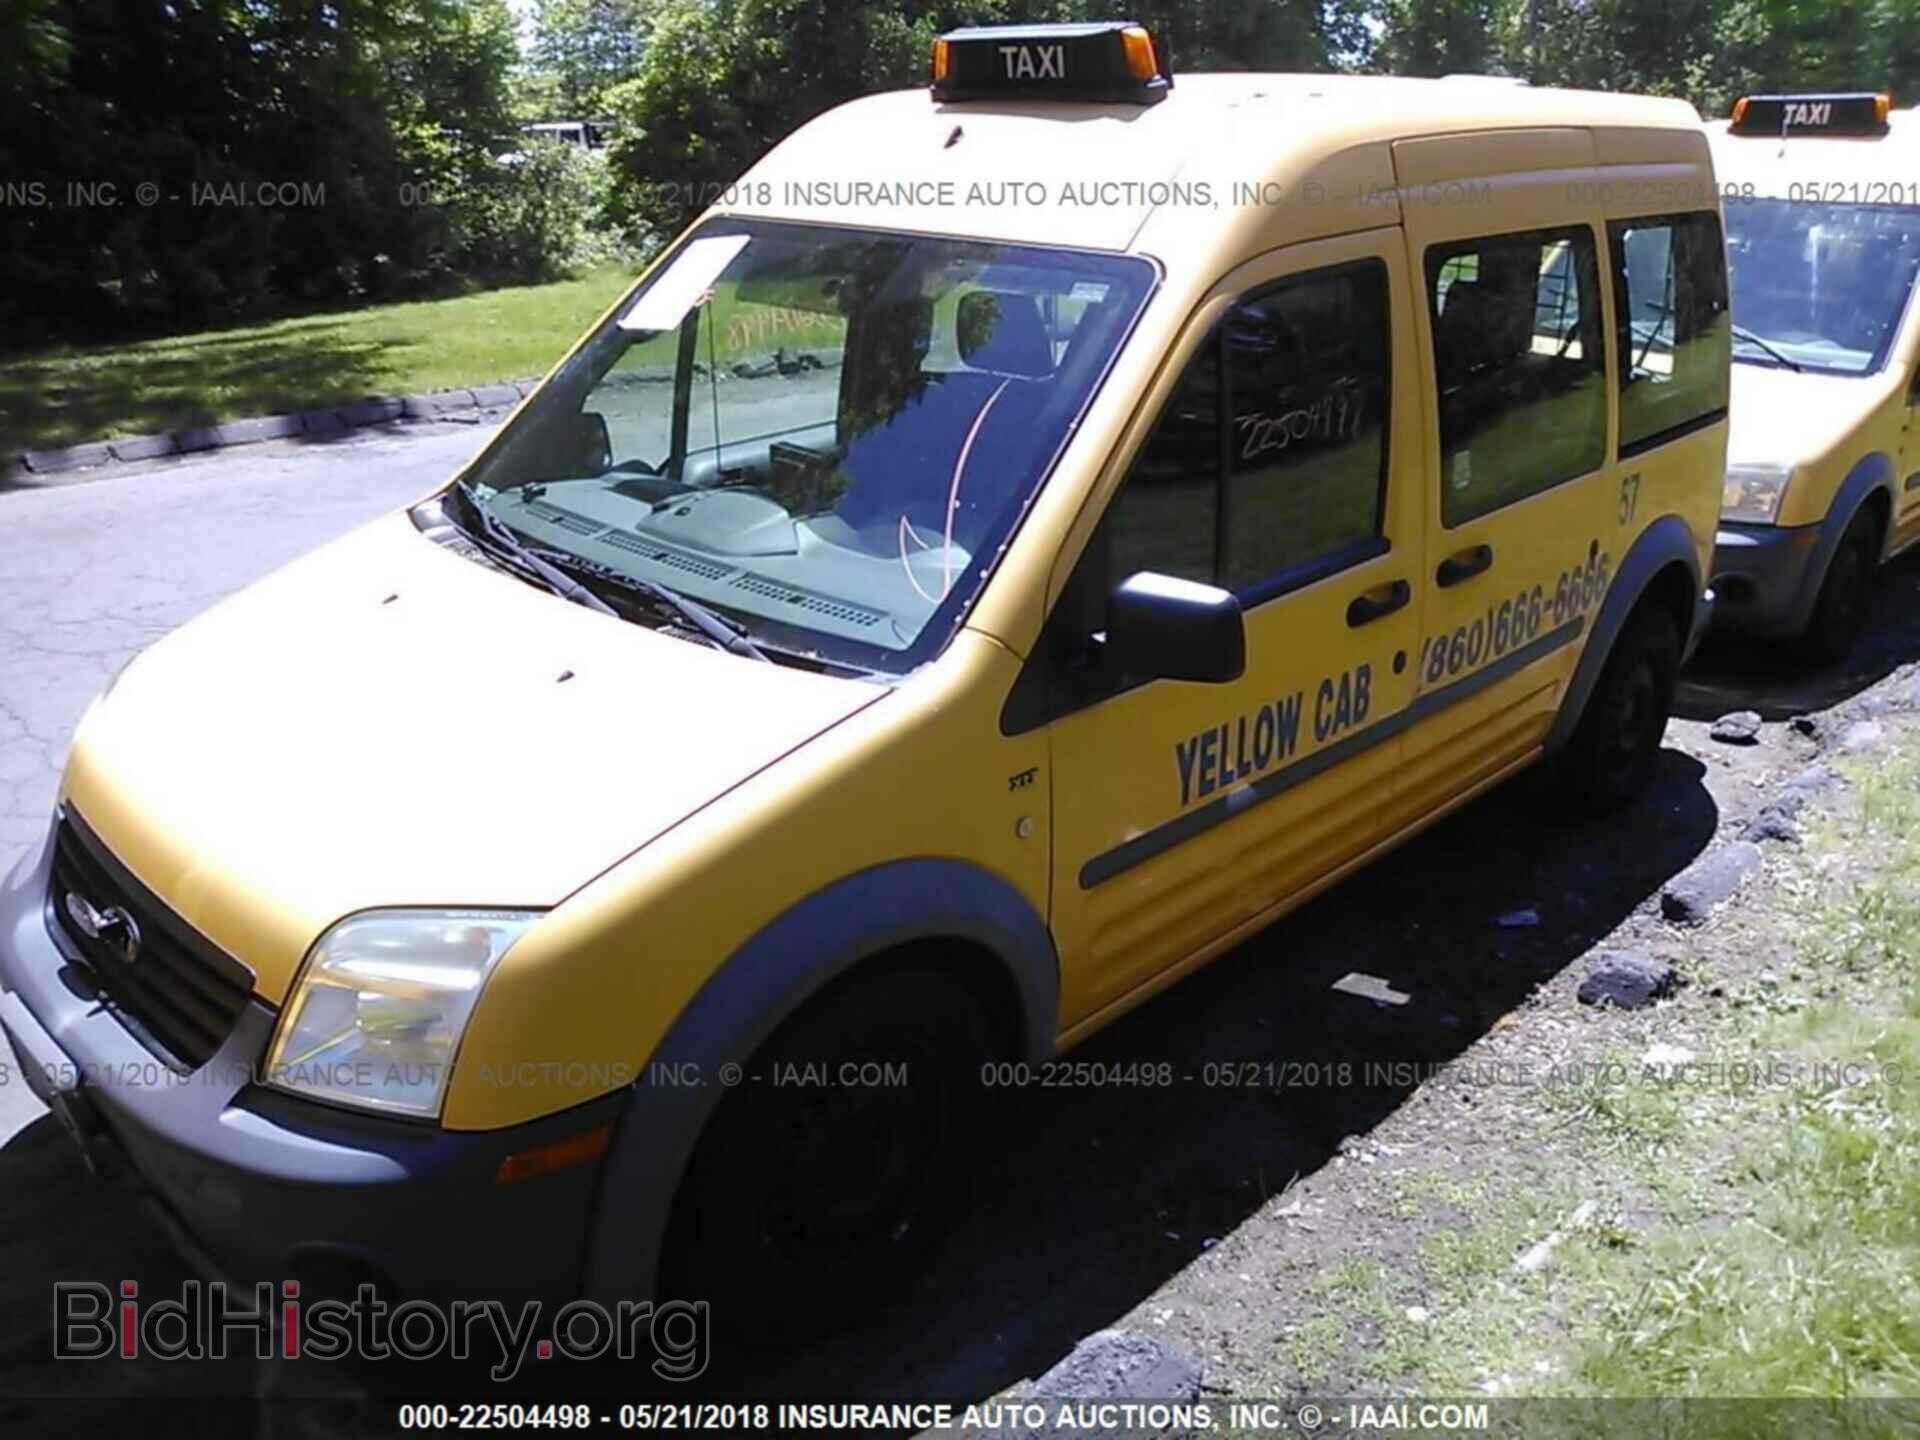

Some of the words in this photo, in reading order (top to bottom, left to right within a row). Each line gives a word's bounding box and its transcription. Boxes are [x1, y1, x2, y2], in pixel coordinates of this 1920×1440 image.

[999, 45, 1065, 80] TAXI
[1783, 102, 1832, 126] TAXI
[1617, 471, 1641, 528] 57
[1174, 690, 1303, 806] YELLOW
[1314, 662, 1372, 742] CAB
